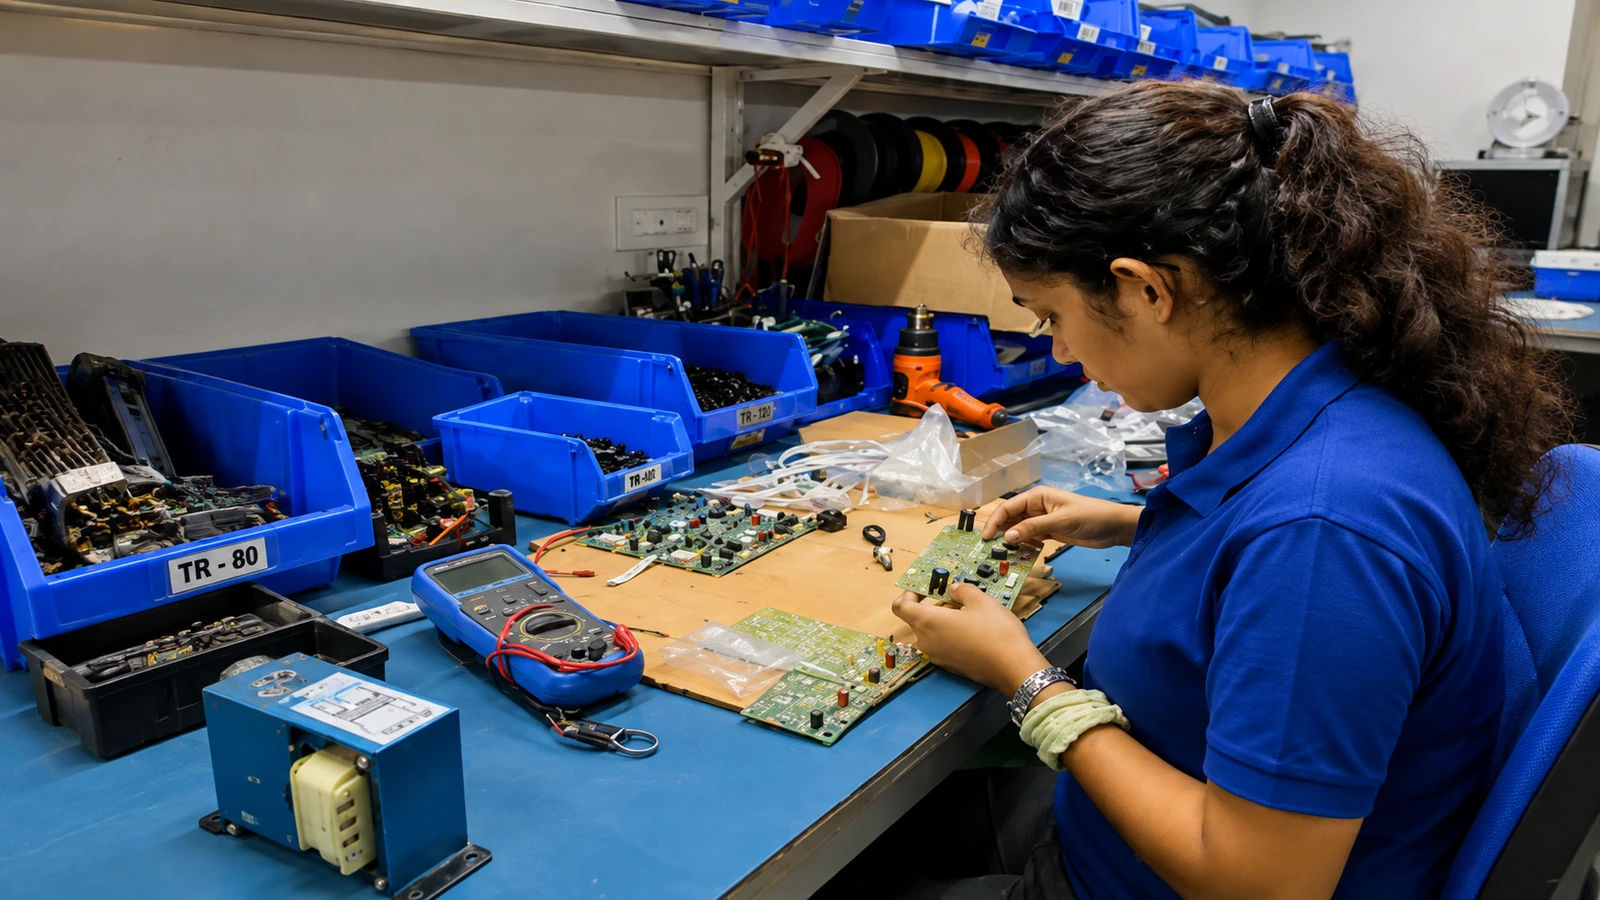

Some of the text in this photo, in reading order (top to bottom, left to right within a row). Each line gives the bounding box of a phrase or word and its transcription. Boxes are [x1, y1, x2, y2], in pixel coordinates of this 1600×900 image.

[740, 411, 752, 424] TR
[629, 473, 641, 488] TR
[177, 558, 212, 583] TR
[232, 545, 259, 569] 80
